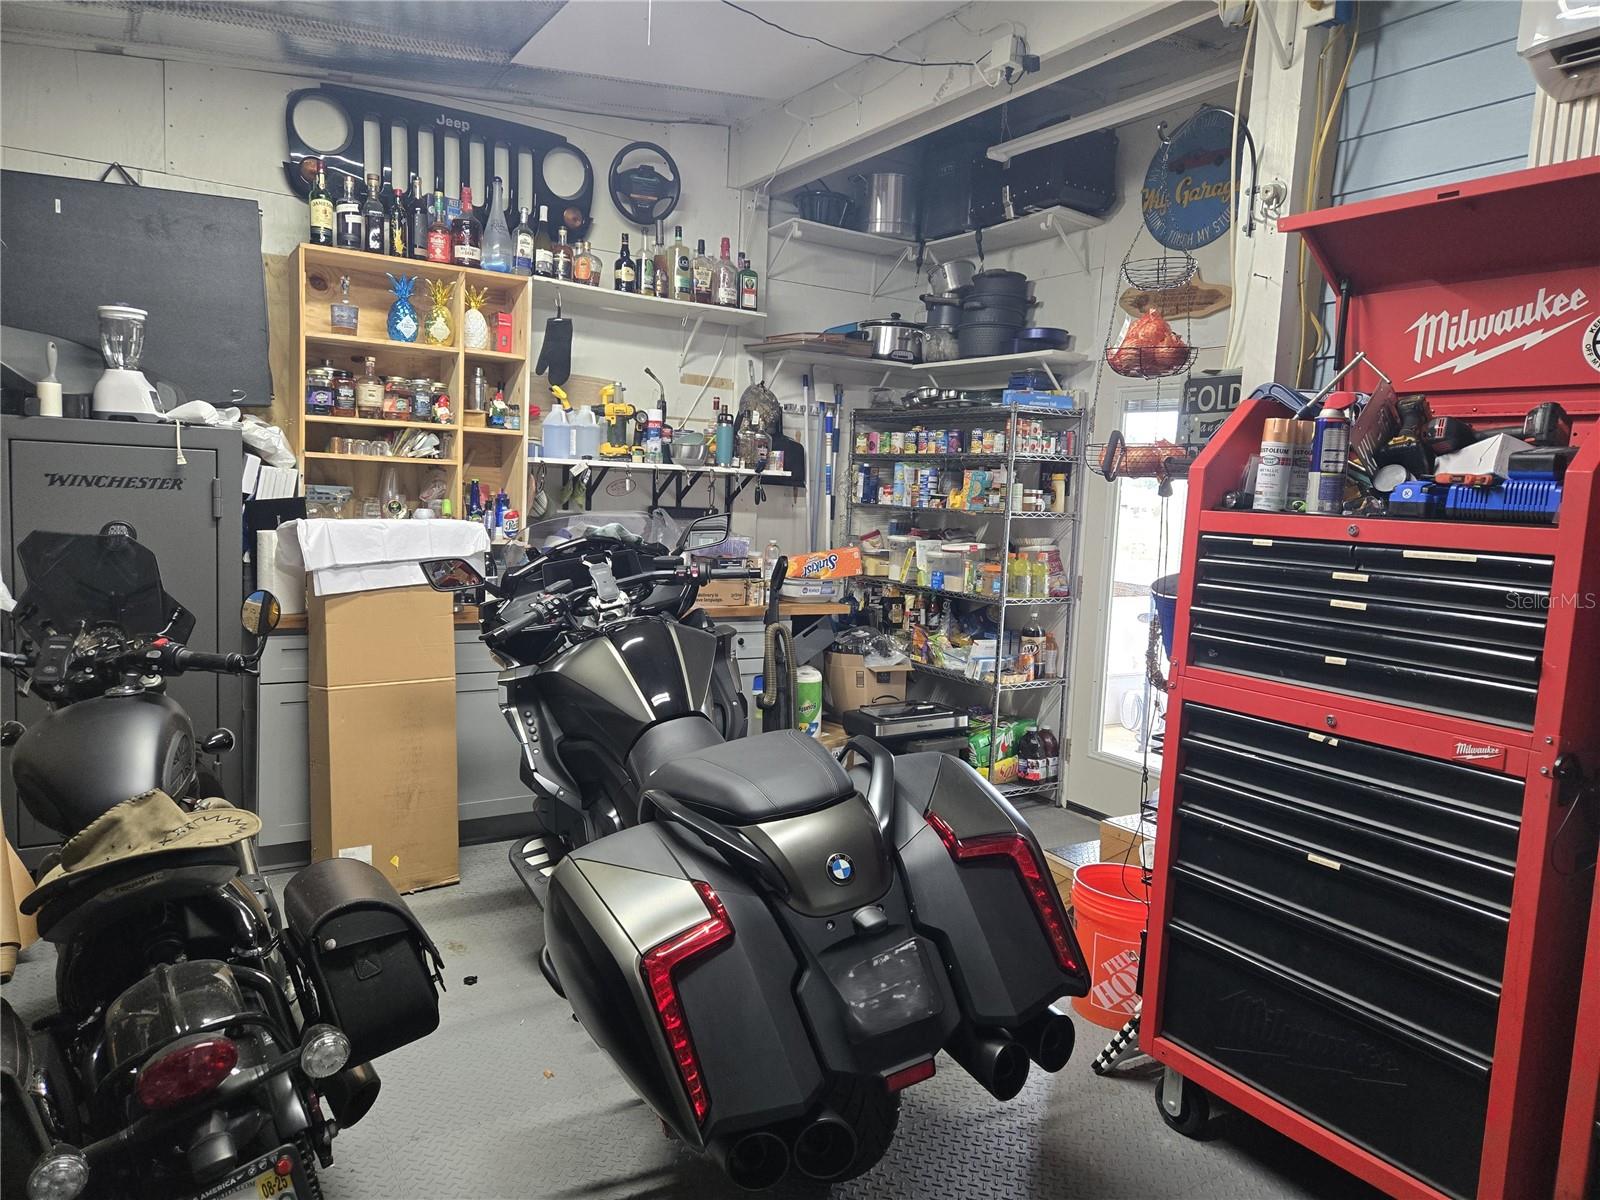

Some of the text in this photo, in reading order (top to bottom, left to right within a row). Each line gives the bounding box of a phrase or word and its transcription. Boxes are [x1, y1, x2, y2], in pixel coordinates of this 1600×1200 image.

[436, 114, 470, 132] Jeep
[1176, 176, 1240, 208] Garag
[1197, 226, 1211, 242] MY
[1404, 287, 1589, 364] Milwaukee
[1186, 383, 1241, 412] FOLD
[44, 472, 184, 491] WINCHESTER
[802, 553, 838, 577] Sunkist
[1454, 742, 1500, 755] Milwaukee
[1101, 950, 1132, 975] THE
[200, 1178, 237, 1200] AMERICA
[261, 1178, 288, 1199] 08-25
